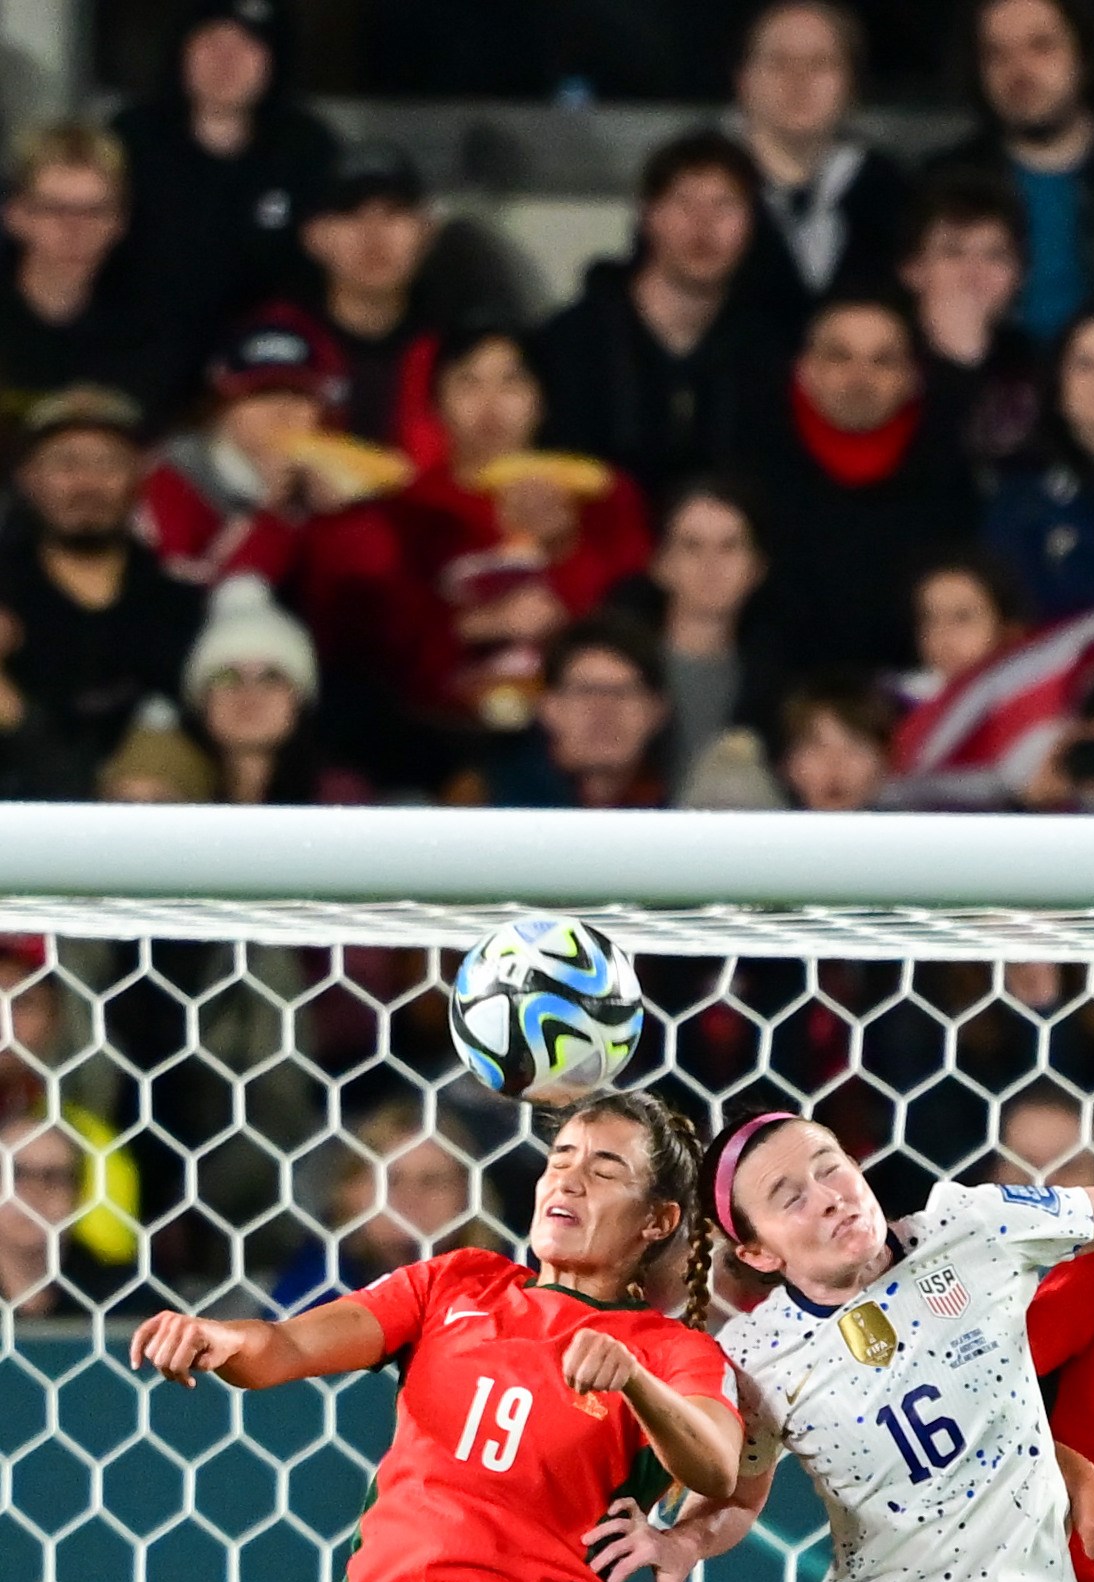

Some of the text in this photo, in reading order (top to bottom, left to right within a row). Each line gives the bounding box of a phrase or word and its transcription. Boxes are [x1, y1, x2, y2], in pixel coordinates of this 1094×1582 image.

[918, 1268, 955, 1294] USA
[866, 1340, 888, 1357] FIFA
[454, 1376, 533, 1472] 19
[876, 1383, 966, 1485] 16
